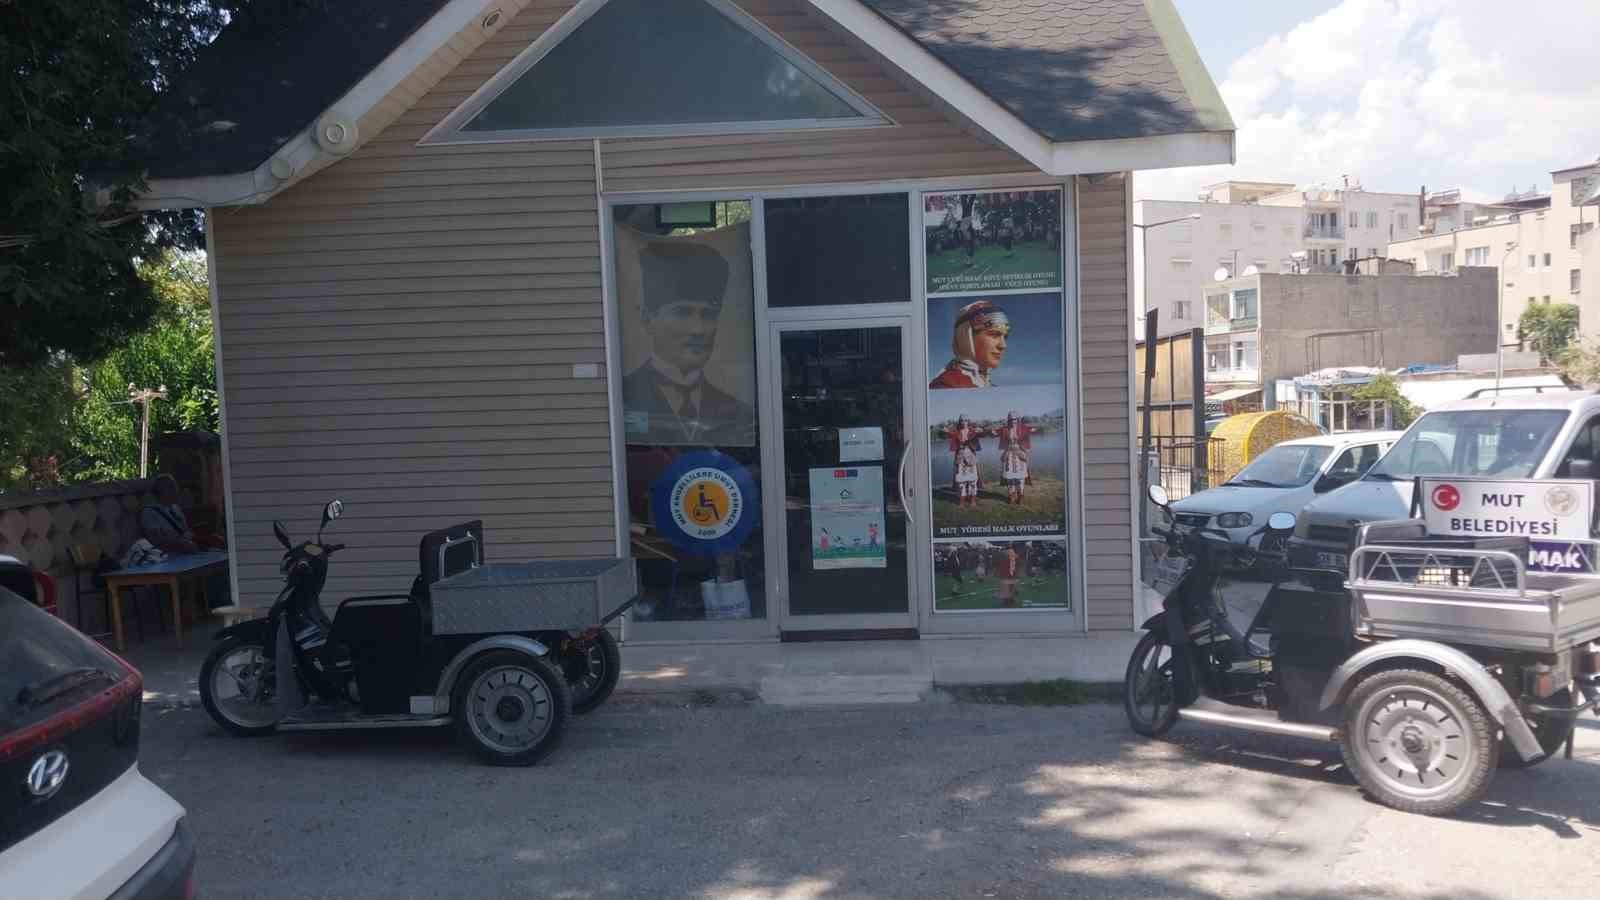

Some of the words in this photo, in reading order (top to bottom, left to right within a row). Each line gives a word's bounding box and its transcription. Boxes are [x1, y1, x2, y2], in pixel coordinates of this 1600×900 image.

[1481, 493, 1525, 508] MUT
[939, 527, 957, 535] MUT
[1450, 516, 1558, 536] BELEDİYESİ
